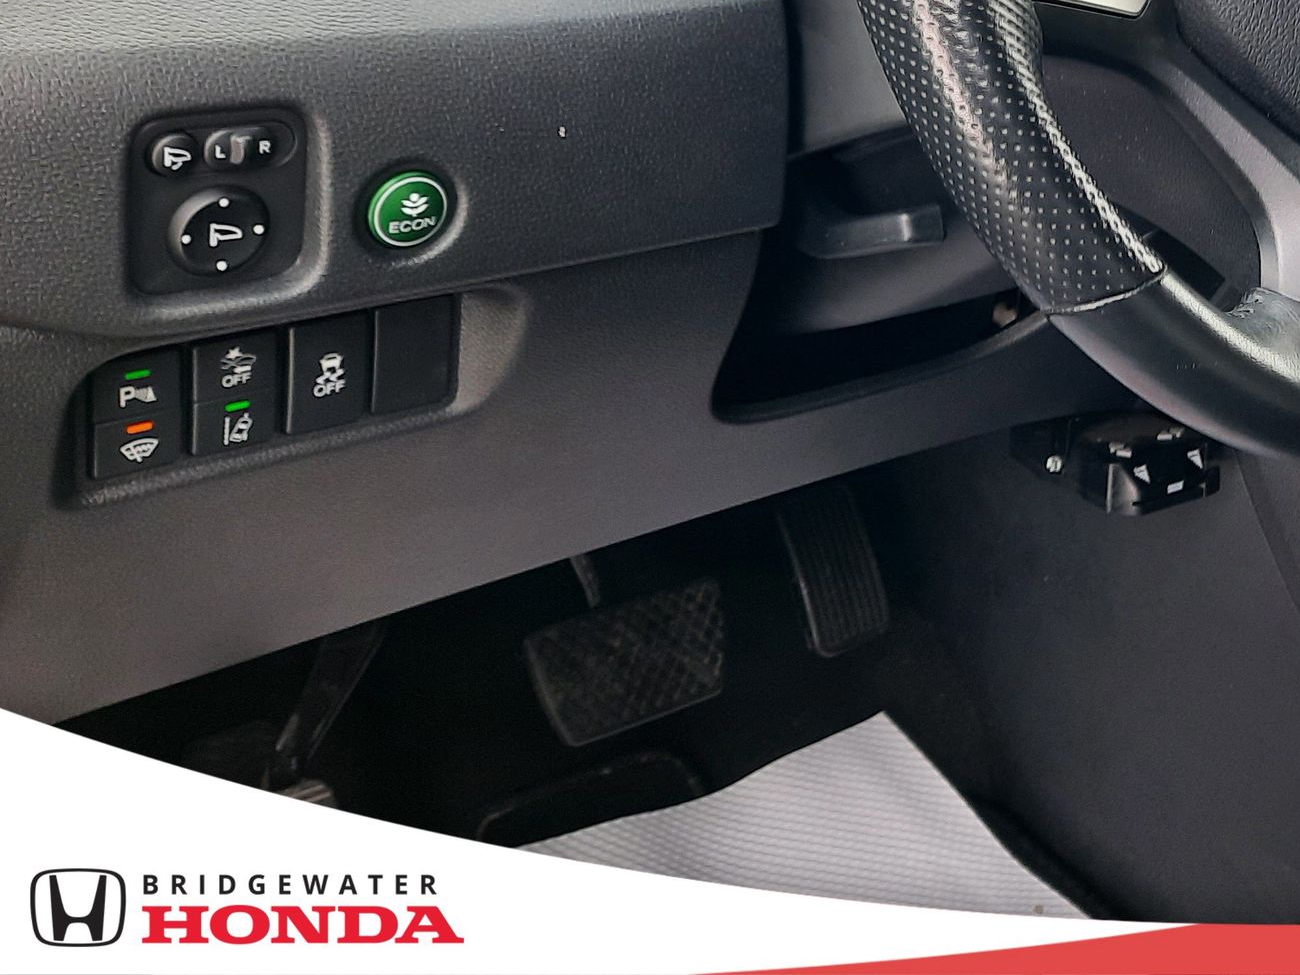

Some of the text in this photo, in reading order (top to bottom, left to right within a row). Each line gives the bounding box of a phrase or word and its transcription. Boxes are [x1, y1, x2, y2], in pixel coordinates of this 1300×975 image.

[215, 139, 272, 159] L R
[388, 215, 437, 236] ECON
[221, 371, 252, 388] OFF
[313, 378, 346, 398] OFF
